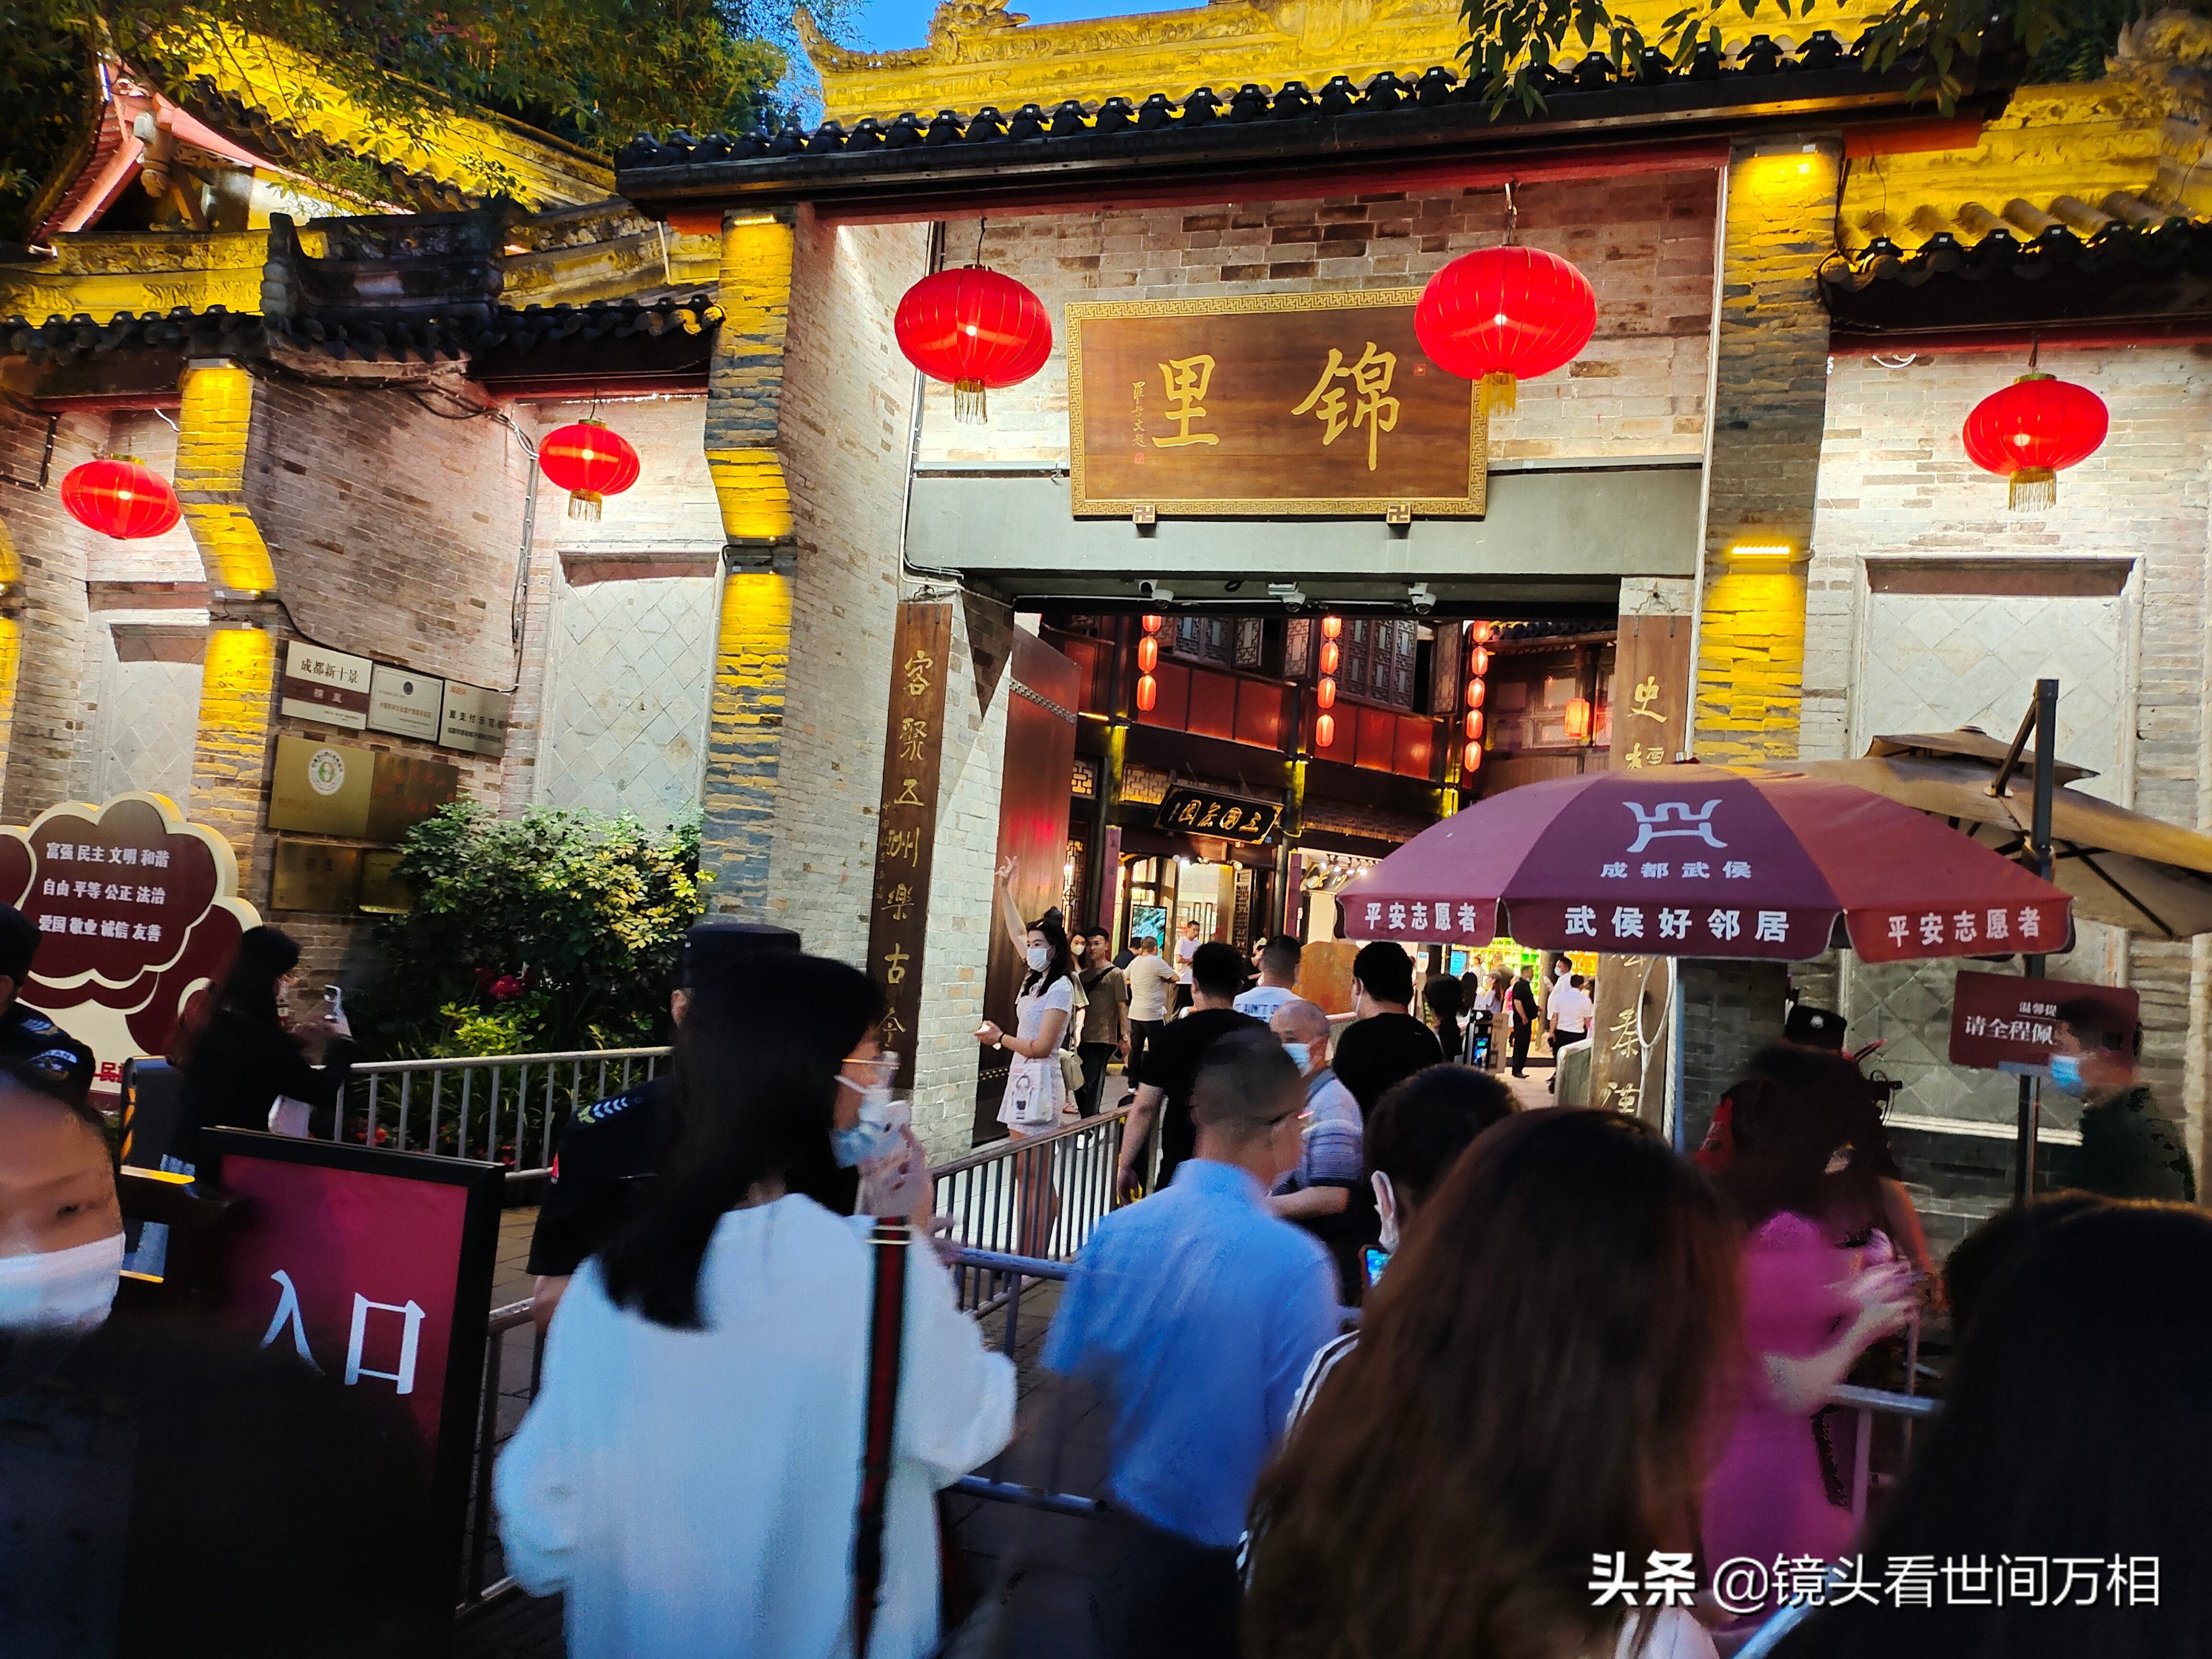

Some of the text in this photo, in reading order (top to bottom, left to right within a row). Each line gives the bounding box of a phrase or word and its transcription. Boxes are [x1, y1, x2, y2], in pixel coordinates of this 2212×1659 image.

[1152, 341, 1400, 471] 锦里
[301, 659, 359, 684] 成都新十景
[47, 842, 170, 868] 富强 民主 文明 和谐
[1600, 860, 1752, 879] 成都武侯
[43, 879, 166, 905] 自由 平等 公正 法治
[38, 914, 162, 943] 爱国 敬业 诚信 友善
[1365, 901, 1476, 933] 平安志愿者
[1564, 905, 1790, 943] 武侯好邻居
[1887, 906, 2041, 948] 平安志愿者
[1964, 1015, 2054, 1045] 请全程佩
[260, 1269, 426, 1395] 入口
